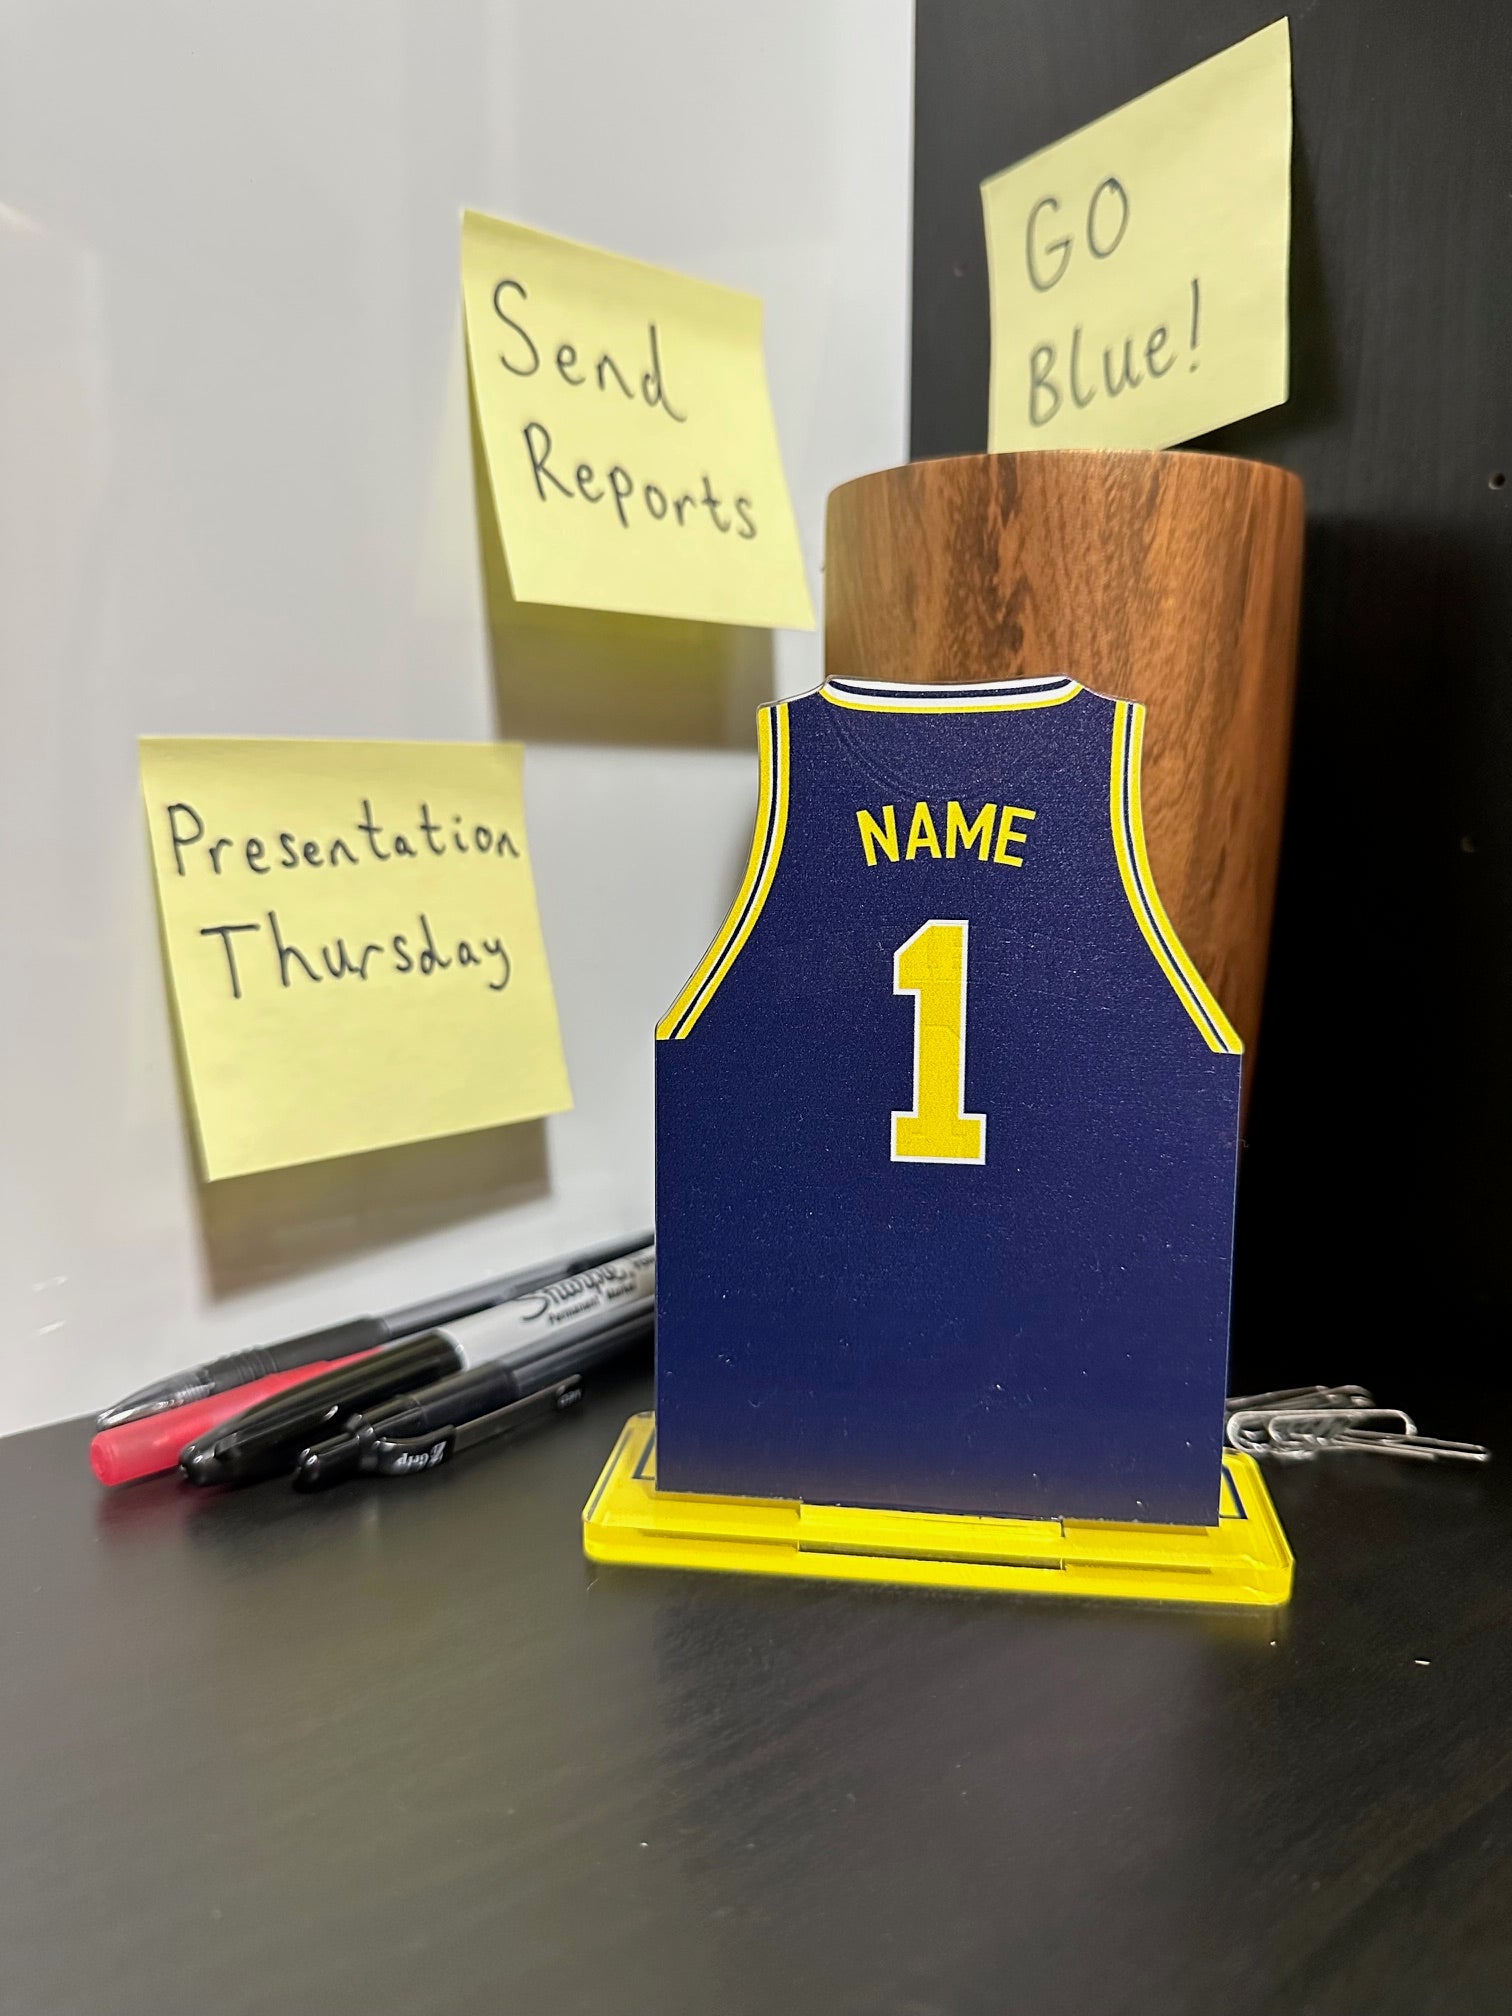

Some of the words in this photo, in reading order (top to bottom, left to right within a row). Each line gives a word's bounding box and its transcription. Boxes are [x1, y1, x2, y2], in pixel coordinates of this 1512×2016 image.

[1026, 177, 1130, 293] GO
[493, 279, 687, 422] Send
[1027, 277, 1201, 428] Blue!
[523, 422, 757, 539] Reports
[167, 799, 520, 877] Presentation
[856, 800, 1036, 867] NAME
[200, 909, 512, 999] Thursday
[890, 919, 986, 1165] 1
[518, 1263, 630, 1322] Sharpie
